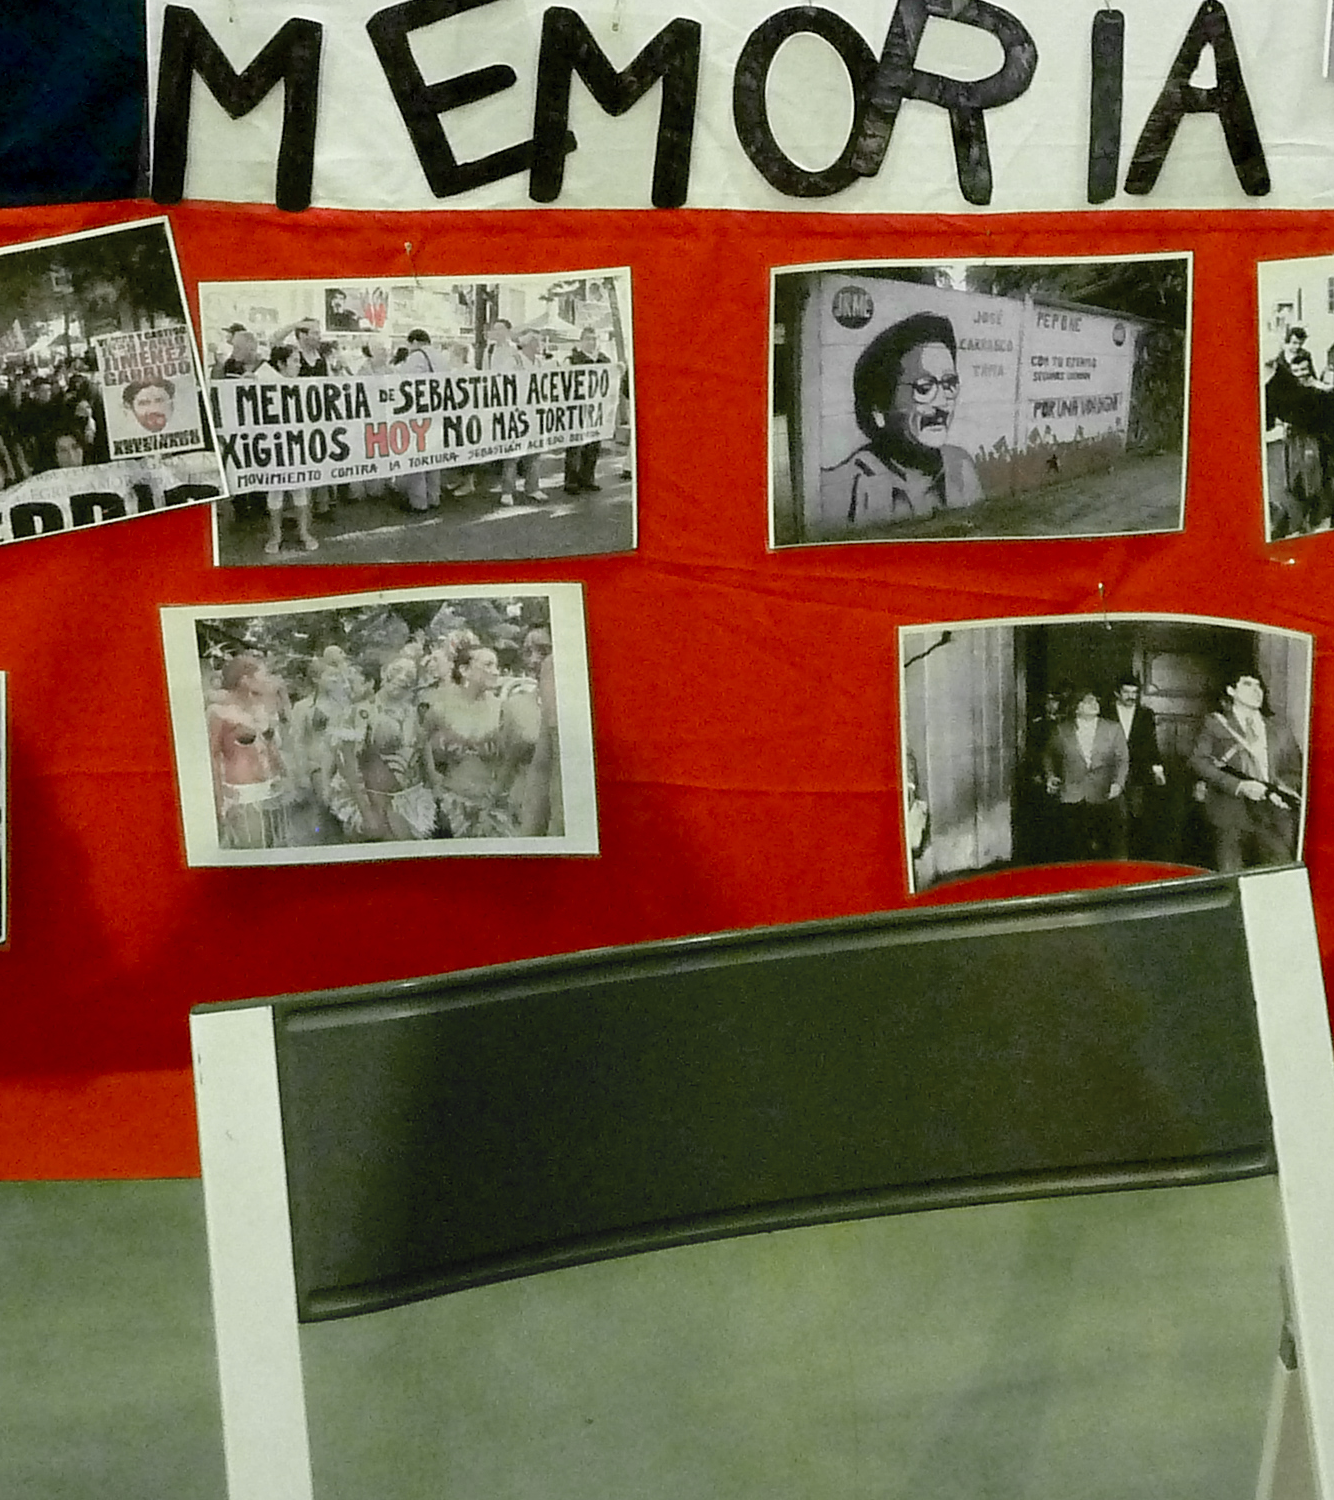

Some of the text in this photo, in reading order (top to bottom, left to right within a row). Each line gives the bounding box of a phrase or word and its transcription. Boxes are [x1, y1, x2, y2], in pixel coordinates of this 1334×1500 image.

[378, 388, 396, 404] DE
[526, 368, 610, 406] ACEVEDO
[365, 417, 433, 460] HOY
[442, 414, 483, 449] NO
[535, 401, 604, 436] TORTURA
[331, 463, 379, 479] CONTRA
[409, 452, 460, 469] TORTURA
[527, 435, 565, 450] ACEEDO
